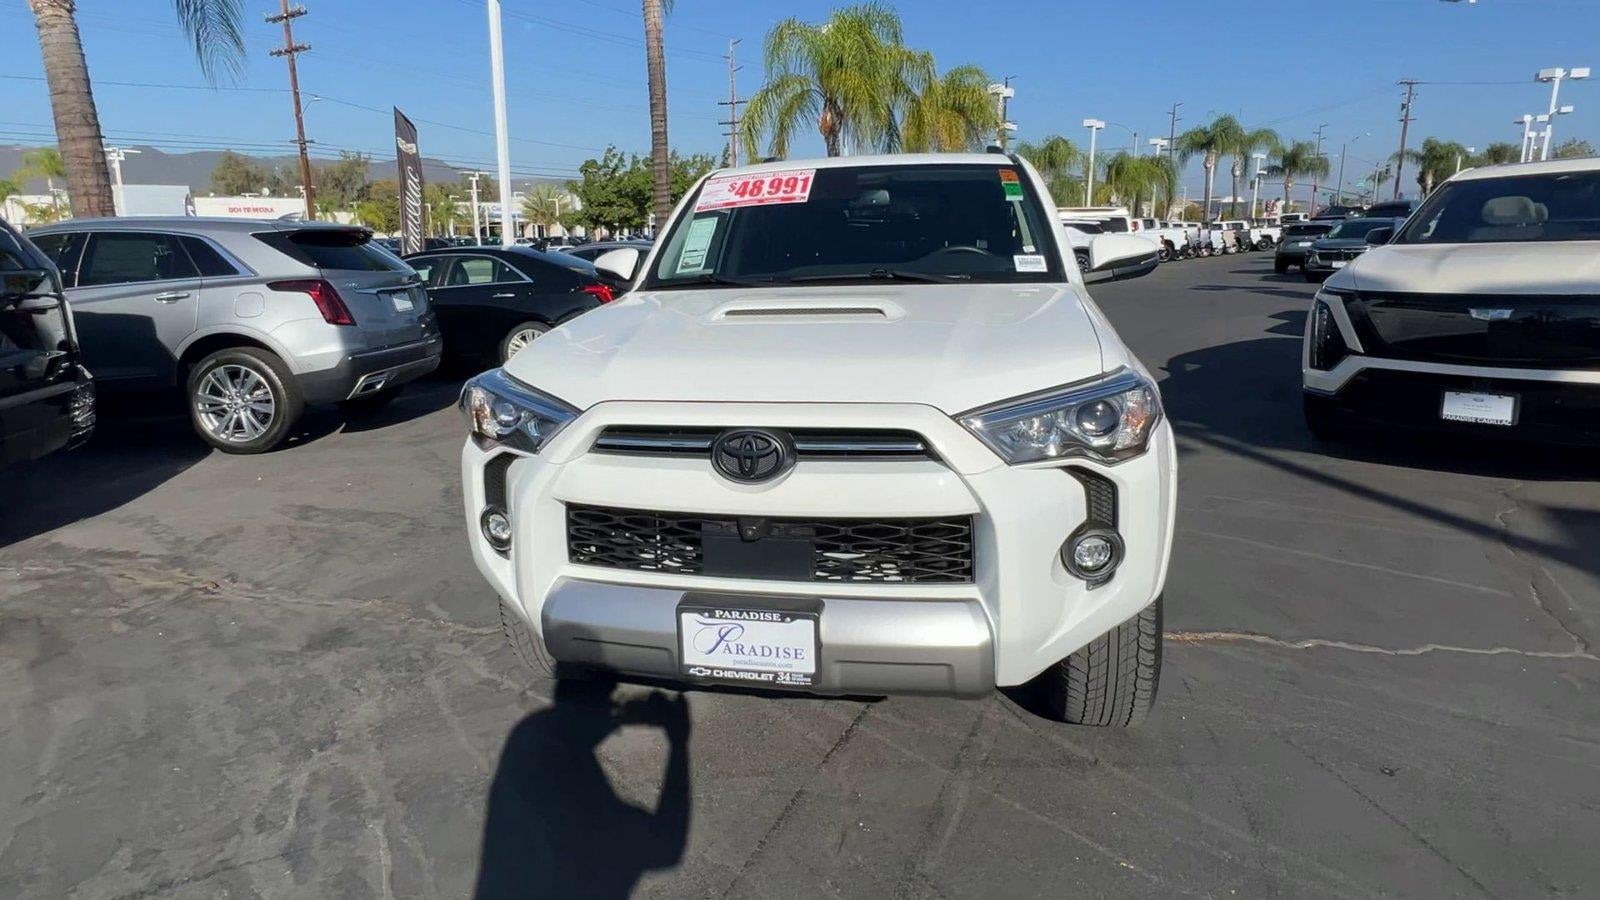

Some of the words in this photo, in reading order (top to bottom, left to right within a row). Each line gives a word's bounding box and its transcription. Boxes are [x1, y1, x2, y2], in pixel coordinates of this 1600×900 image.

[403, 166, 422, 254] adillac
[715, 610, 781, 622] PARADISE
[693, 619, 805, 660] PARADISE
[713, 670, 774, 681] CHEVROLET
[777, 671, 791, 683] 34
